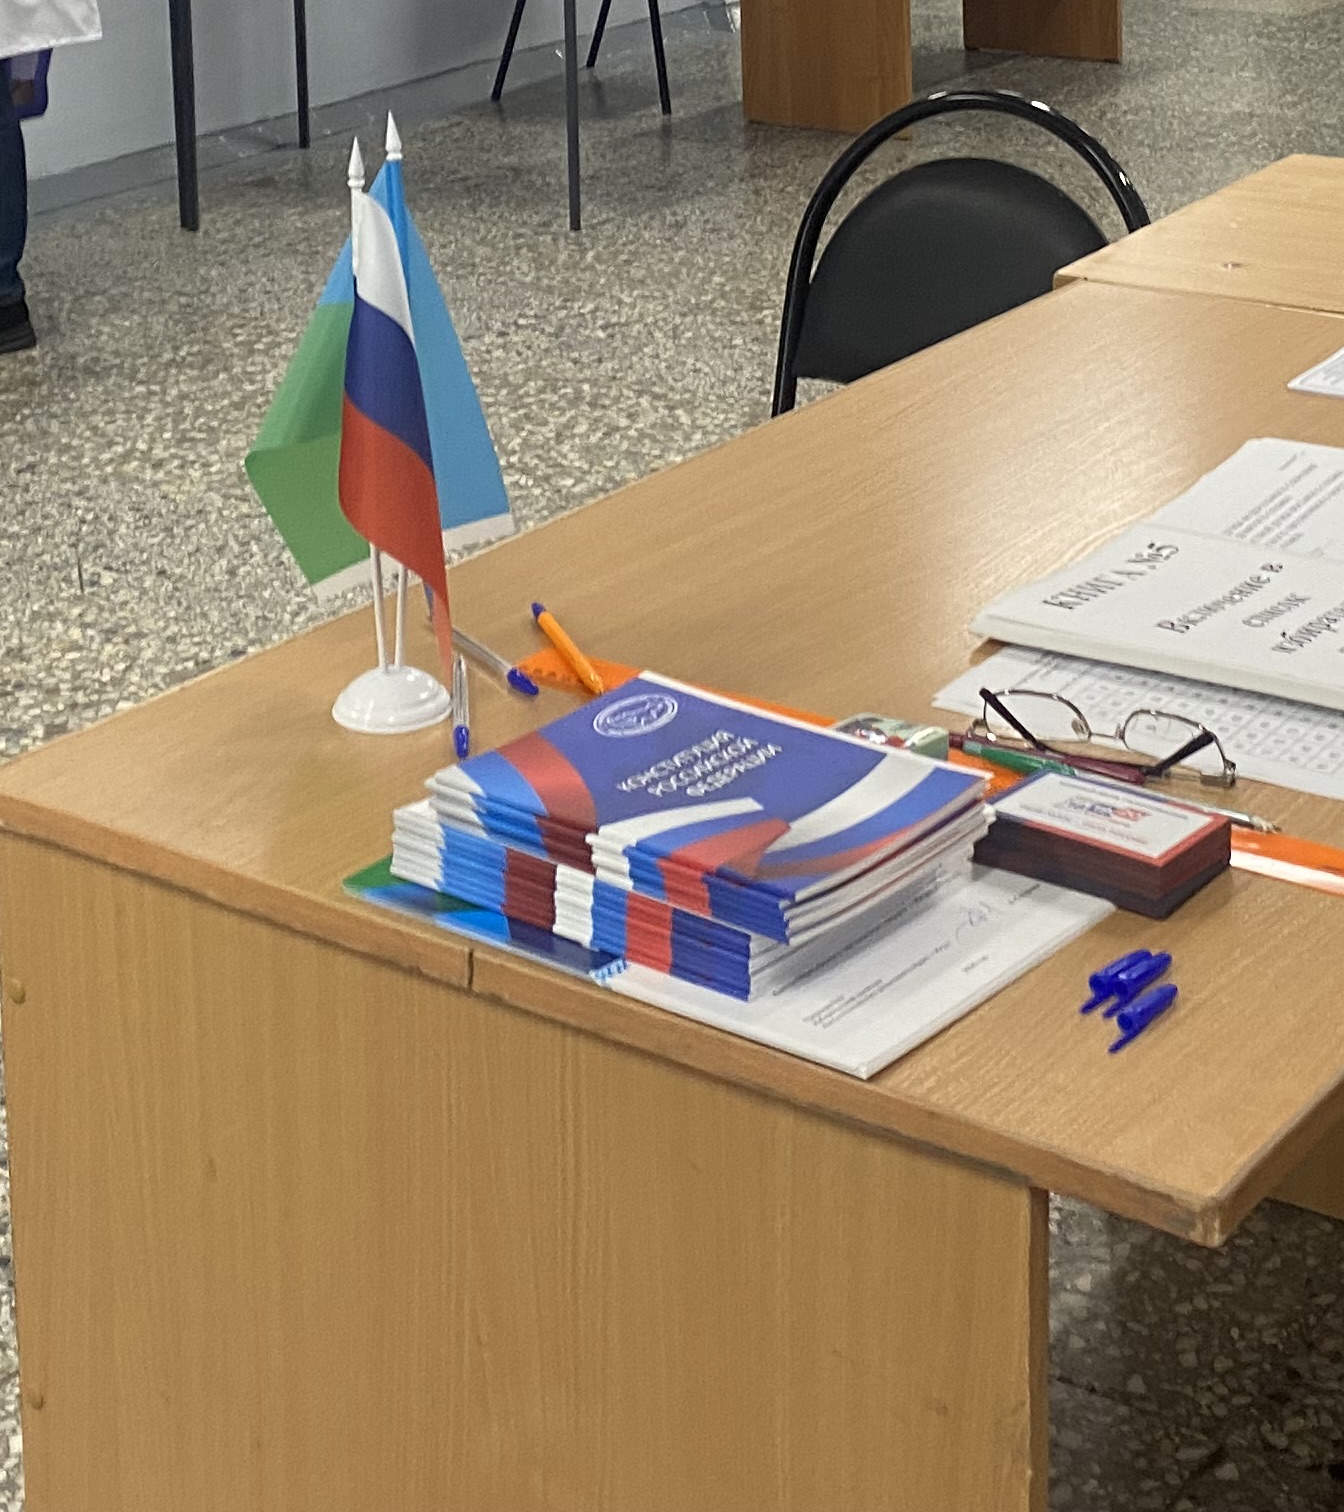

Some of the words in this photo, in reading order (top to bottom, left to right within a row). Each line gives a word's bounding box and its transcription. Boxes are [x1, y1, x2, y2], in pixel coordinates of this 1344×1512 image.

[1042, 566, 1145, 610] КНИГА
[1154, 574, 1271, 634] Включение
[1242, 592, 1312, 629] список
